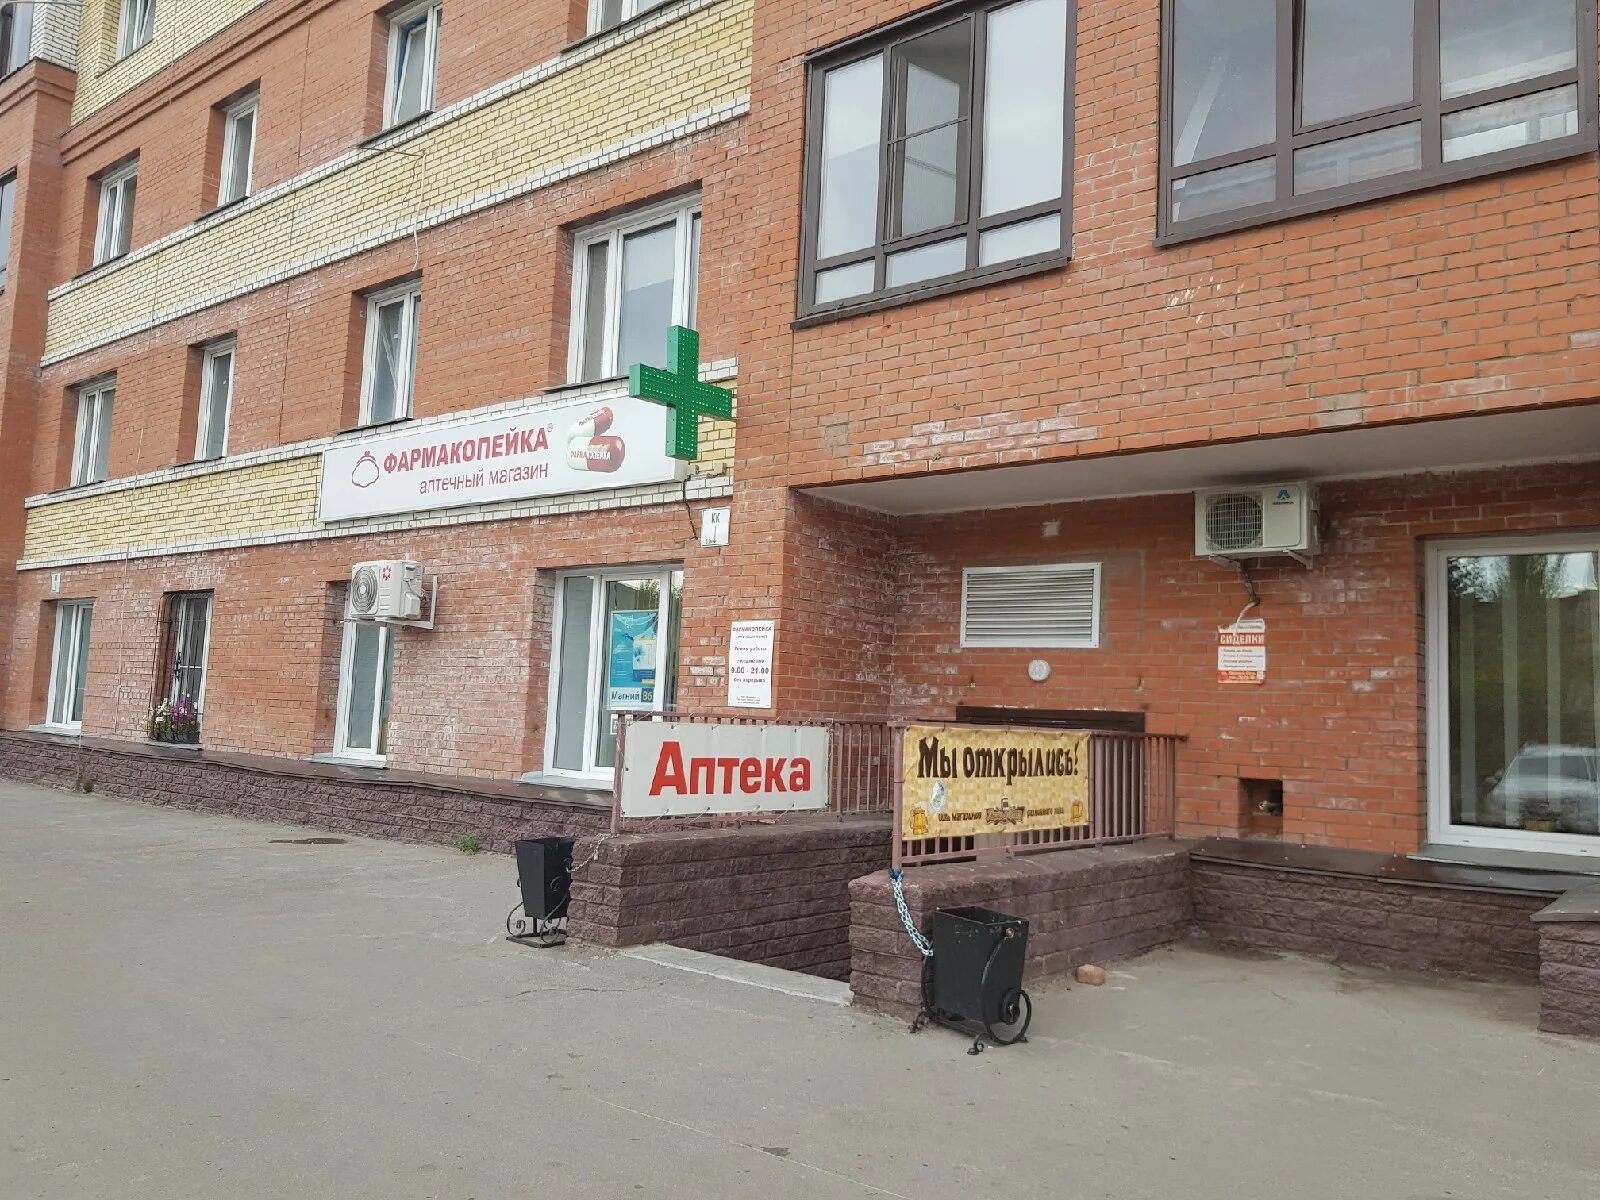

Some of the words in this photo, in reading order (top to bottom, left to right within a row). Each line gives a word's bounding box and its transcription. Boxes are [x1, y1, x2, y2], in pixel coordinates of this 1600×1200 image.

[383, 426, 549, 474] ФАРМАКОПЕЙКА
[419, 468, 484, 495] аптечный
[489, 462, 549, 486] магазин
[1220, 633, 1264, 645] СИДЕЛКИ
[751, 667, 769, 675] 21.00
[649, 741, 811, 796] Аптека
[917, 736, 957, 778] Мы
[963, 737, 1079, 786] открылись!
